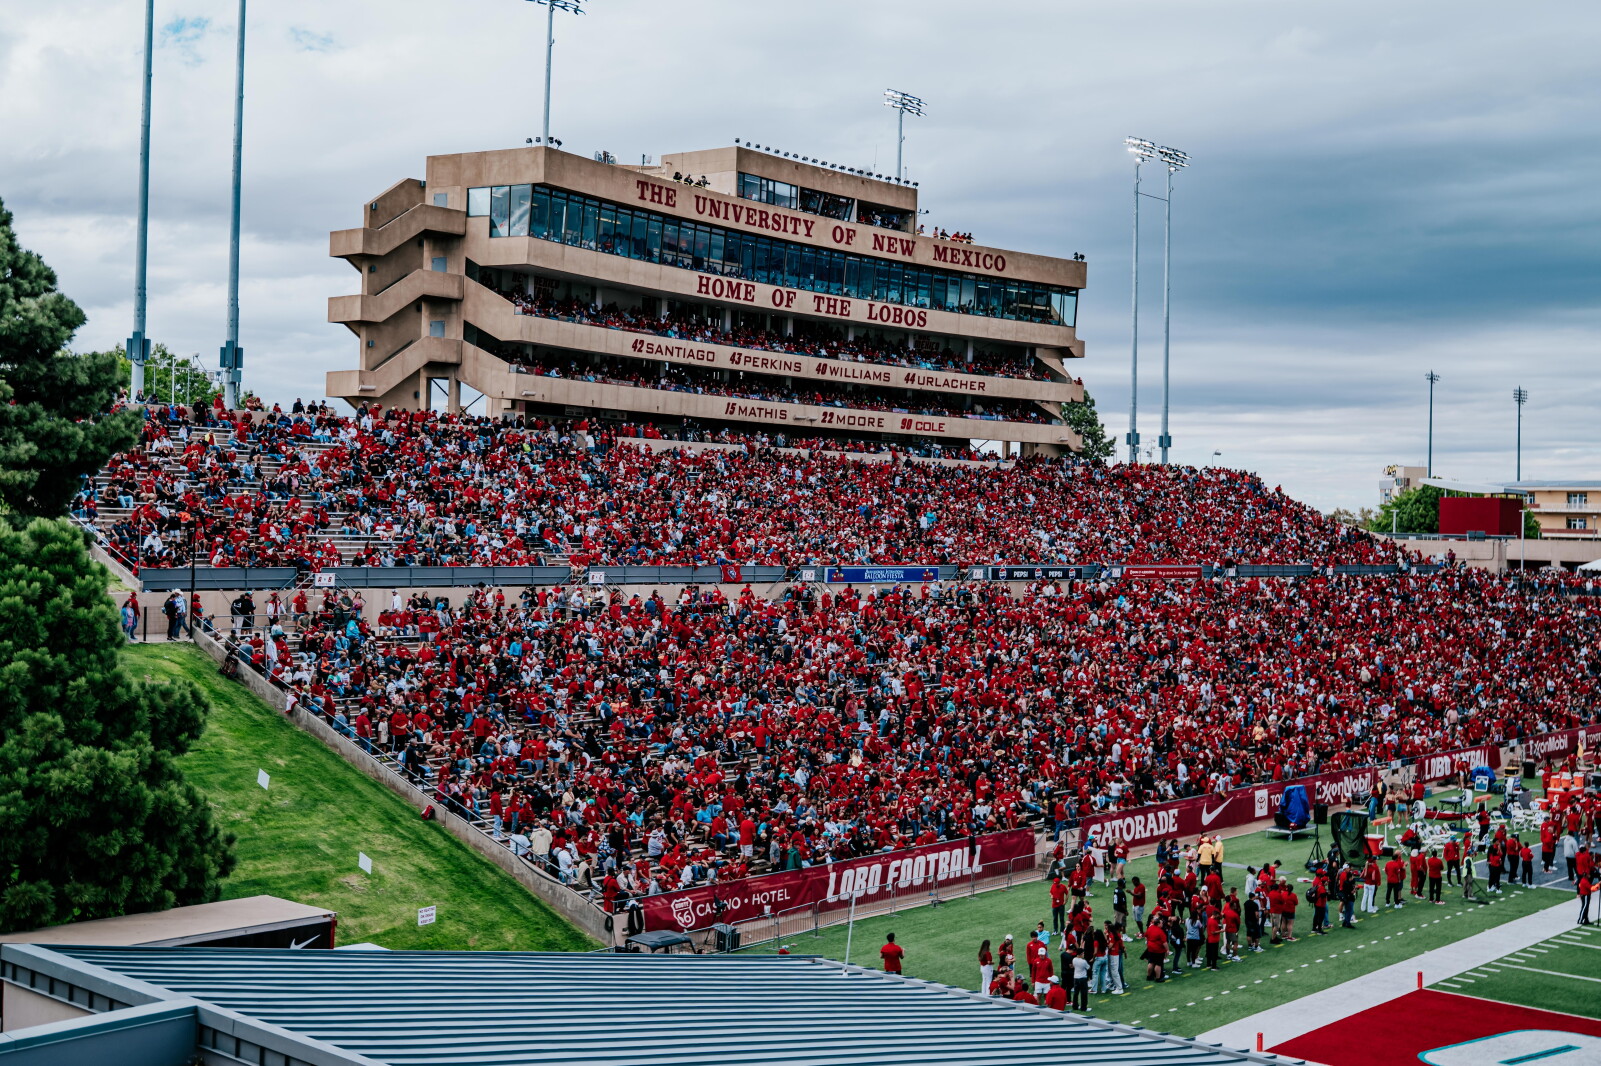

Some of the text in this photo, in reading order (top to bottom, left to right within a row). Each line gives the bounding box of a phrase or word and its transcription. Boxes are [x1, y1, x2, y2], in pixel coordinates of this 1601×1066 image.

[636, 179, 1006, 272] THE UNIVERSITY OF NEW MEXICO
[697, 275, 927, 328] HOME OF THE LOBOS
[632, 338, 986, 392] 42 SANTIAGO 43 PERKINS 40 WILLIAMS 44 URLACHER
[725, 402, 946, 433] 15 MATHIS 22 MOORE 90 COLE
[1013, 570, 1029, 578] PEPSI
[1048, 570, 1063, 578] PEPSI
[1425, 755, 1451, 780] LOBO
[1315, 772, 1371, 804] ExxonMobil
[1087, 808, 1179, 847] GATORADE
[826, 844, 983, 903] LOBO FOOTBALL
[696, 888, 791, 917] CASNO HOTEL
